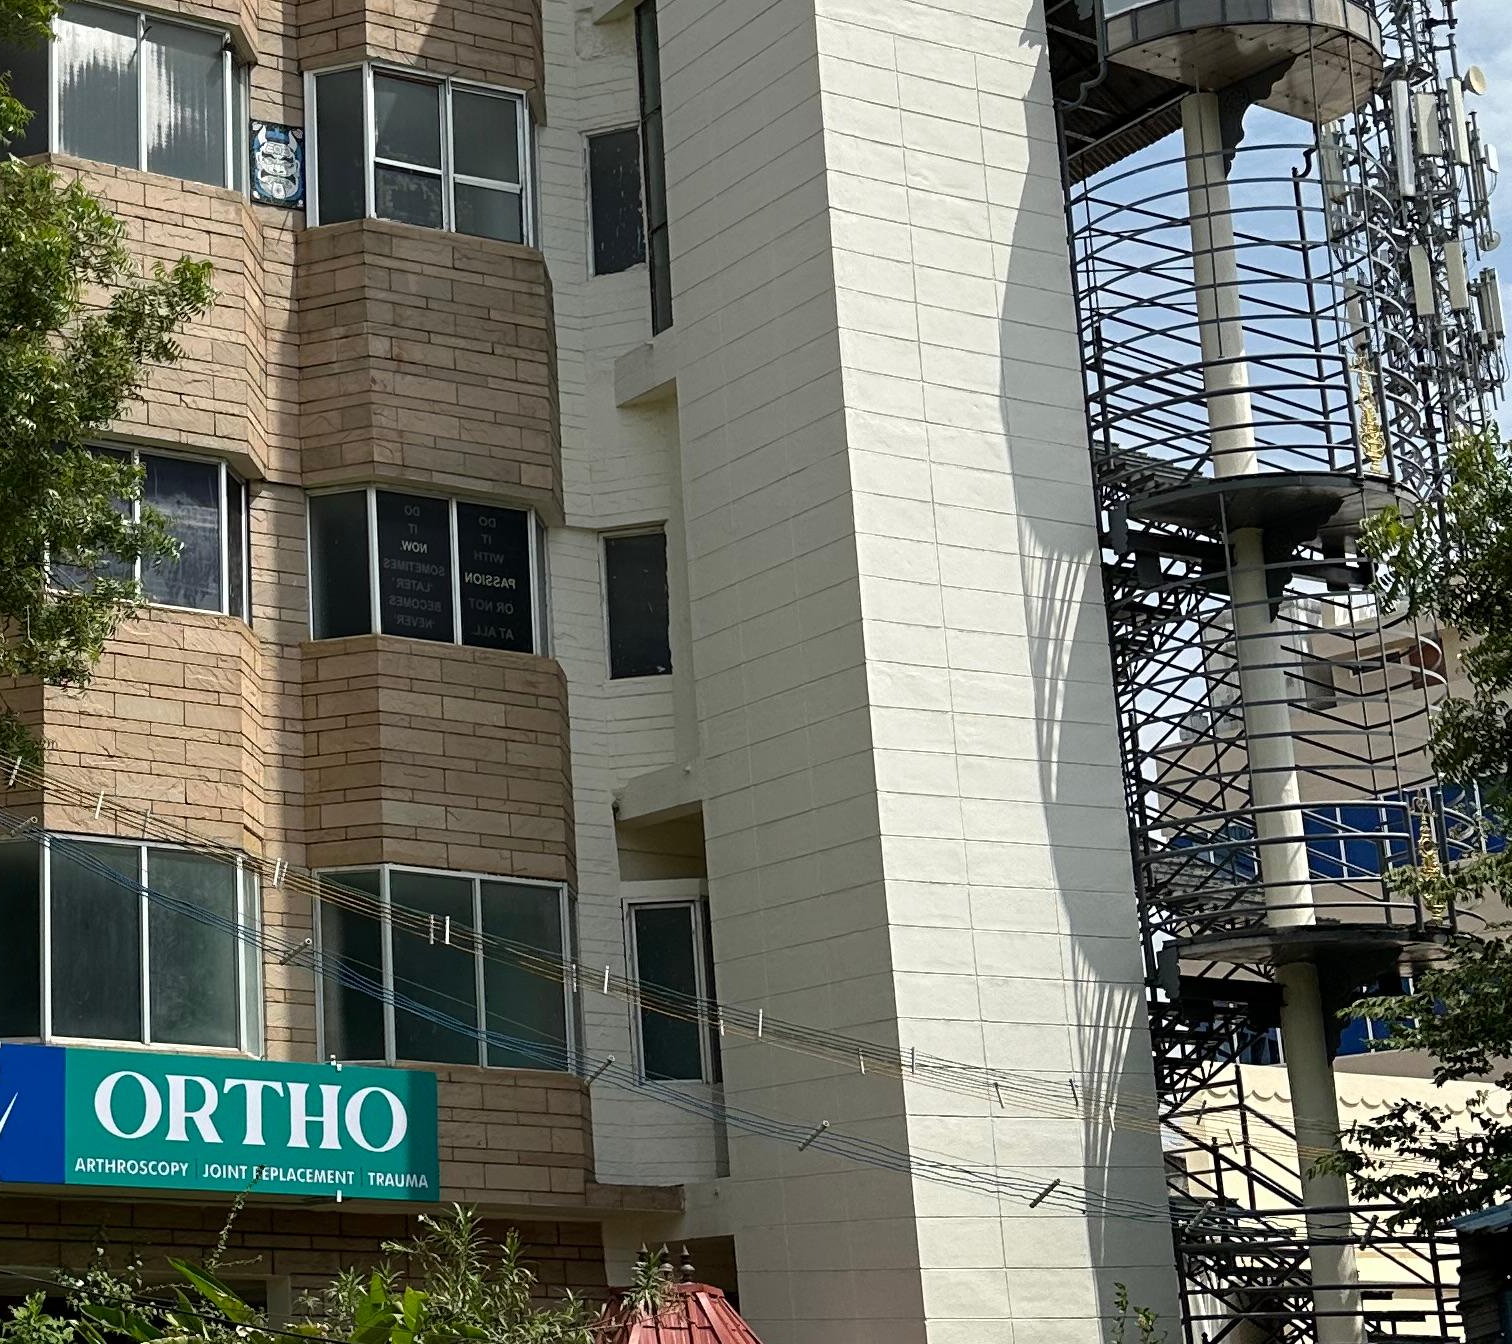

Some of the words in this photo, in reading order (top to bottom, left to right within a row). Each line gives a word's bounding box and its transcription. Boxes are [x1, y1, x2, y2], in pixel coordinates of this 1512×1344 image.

[94, 1071, 408, 1152] ORTHO
[75, 1158, 188, 1177] ARTHROSCOPY
[203, 1164, 248, 1180] JOINT
[368, 1172, 429, 1188] TRAUMA
